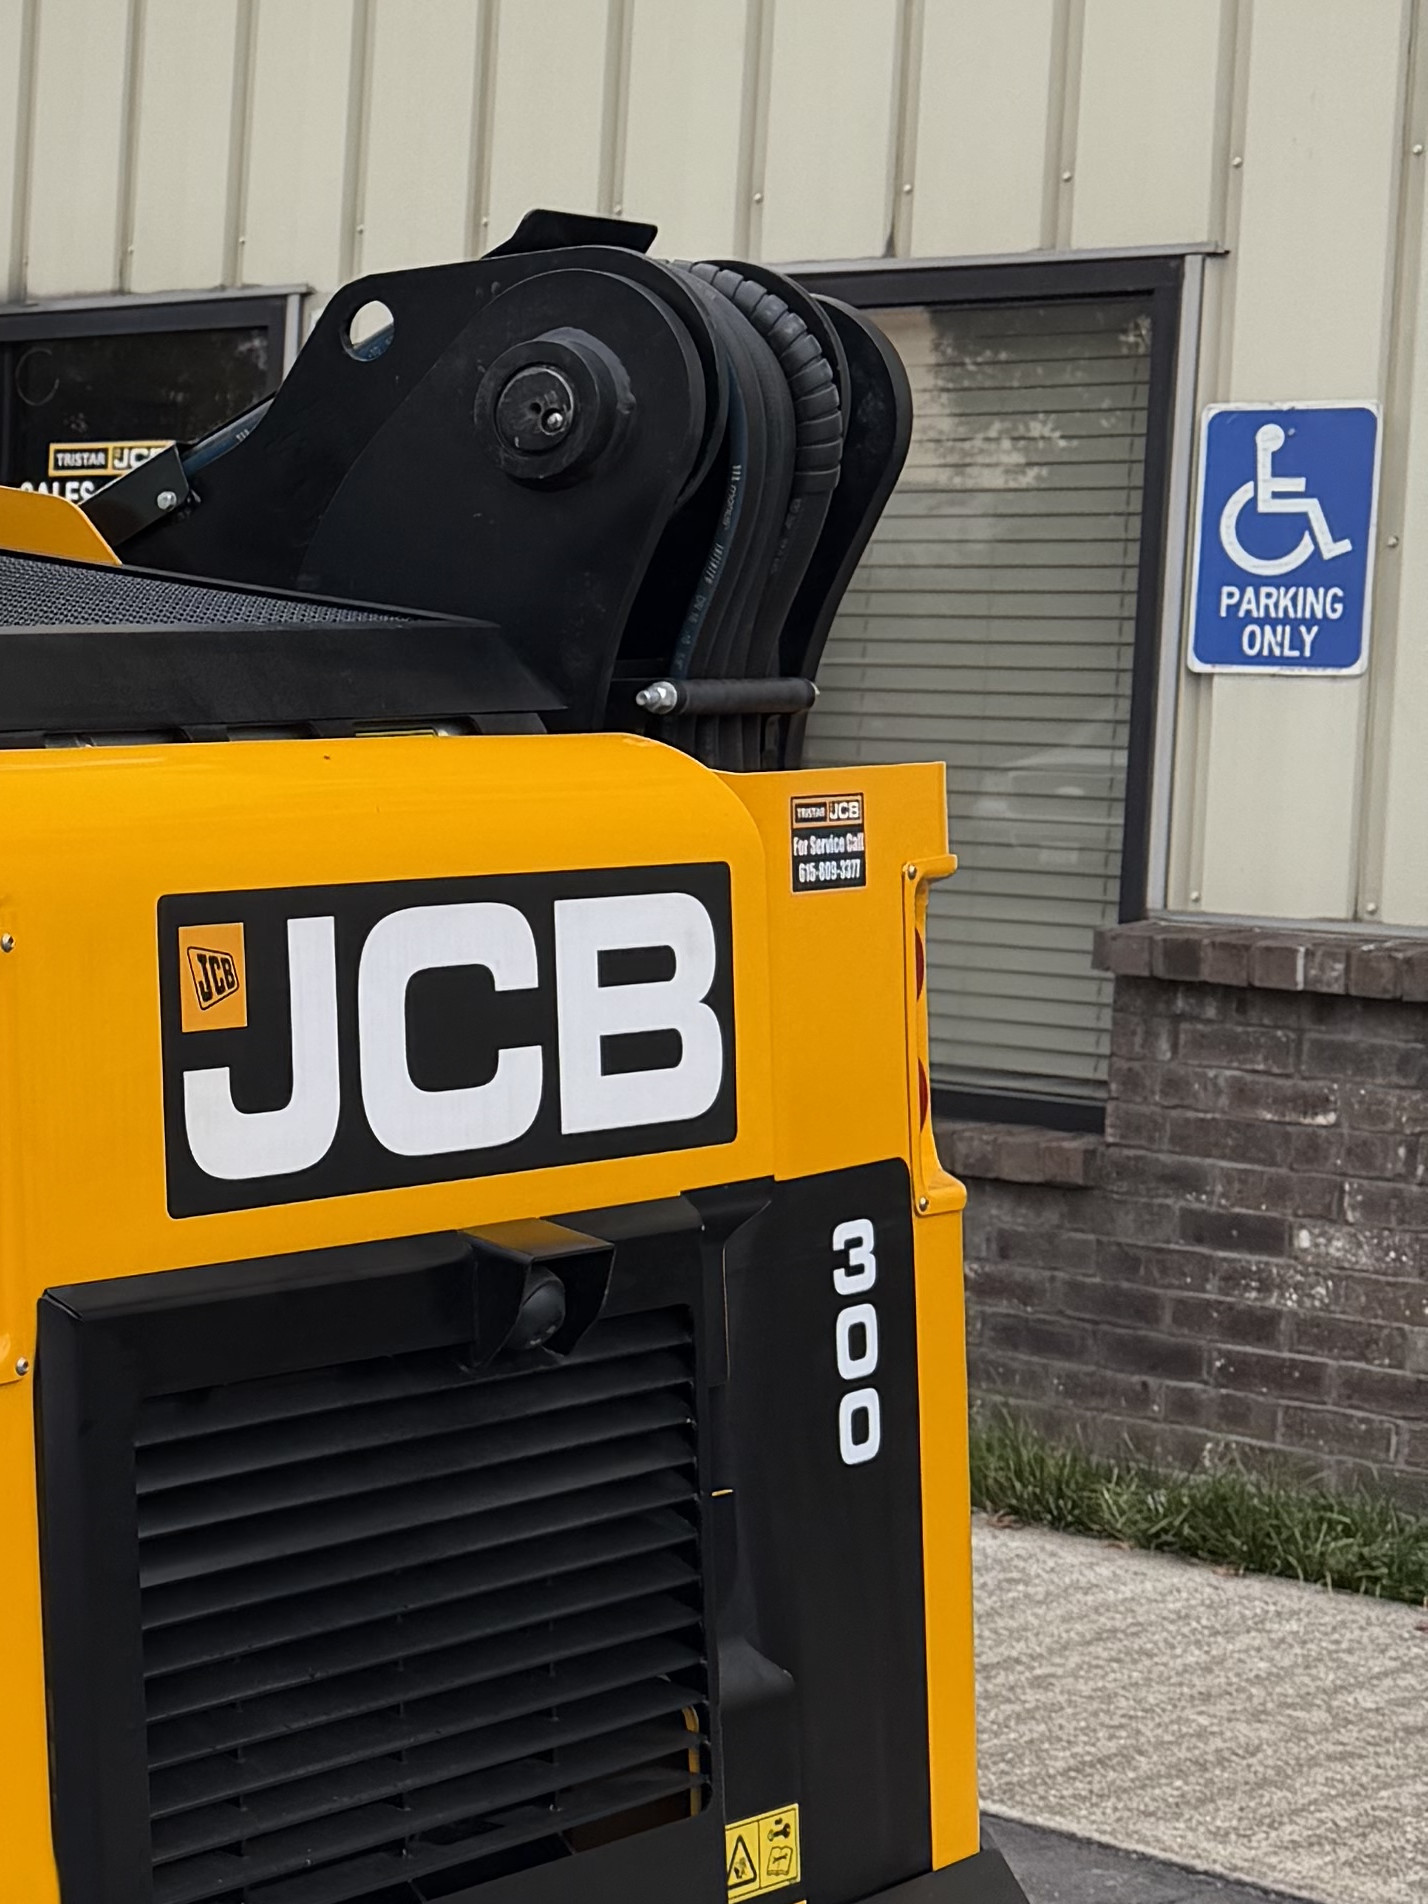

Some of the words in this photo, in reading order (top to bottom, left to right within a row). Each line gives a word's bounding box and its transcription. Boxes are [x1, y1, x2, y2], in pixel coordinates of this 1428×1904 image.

[56, 452, 106, 467] TRISTAR
[113, 447, 166, 469] JC
[1219, 585, 1344, 620] PARKING
[1242, 623, 1319, 658] ONLY
[829, 801, 859, 820] JCB
[793, 836, 808, 856] For
[809, 834, 845, 855] Service
[846, 832, 865, 853] Call
[798, 859, 861, 883] 615-809-3377
[196, 953, 236, 1002] JCB
[183, 892, 723, 1180] JCB
[832, 1218, 881, 1465] 300
